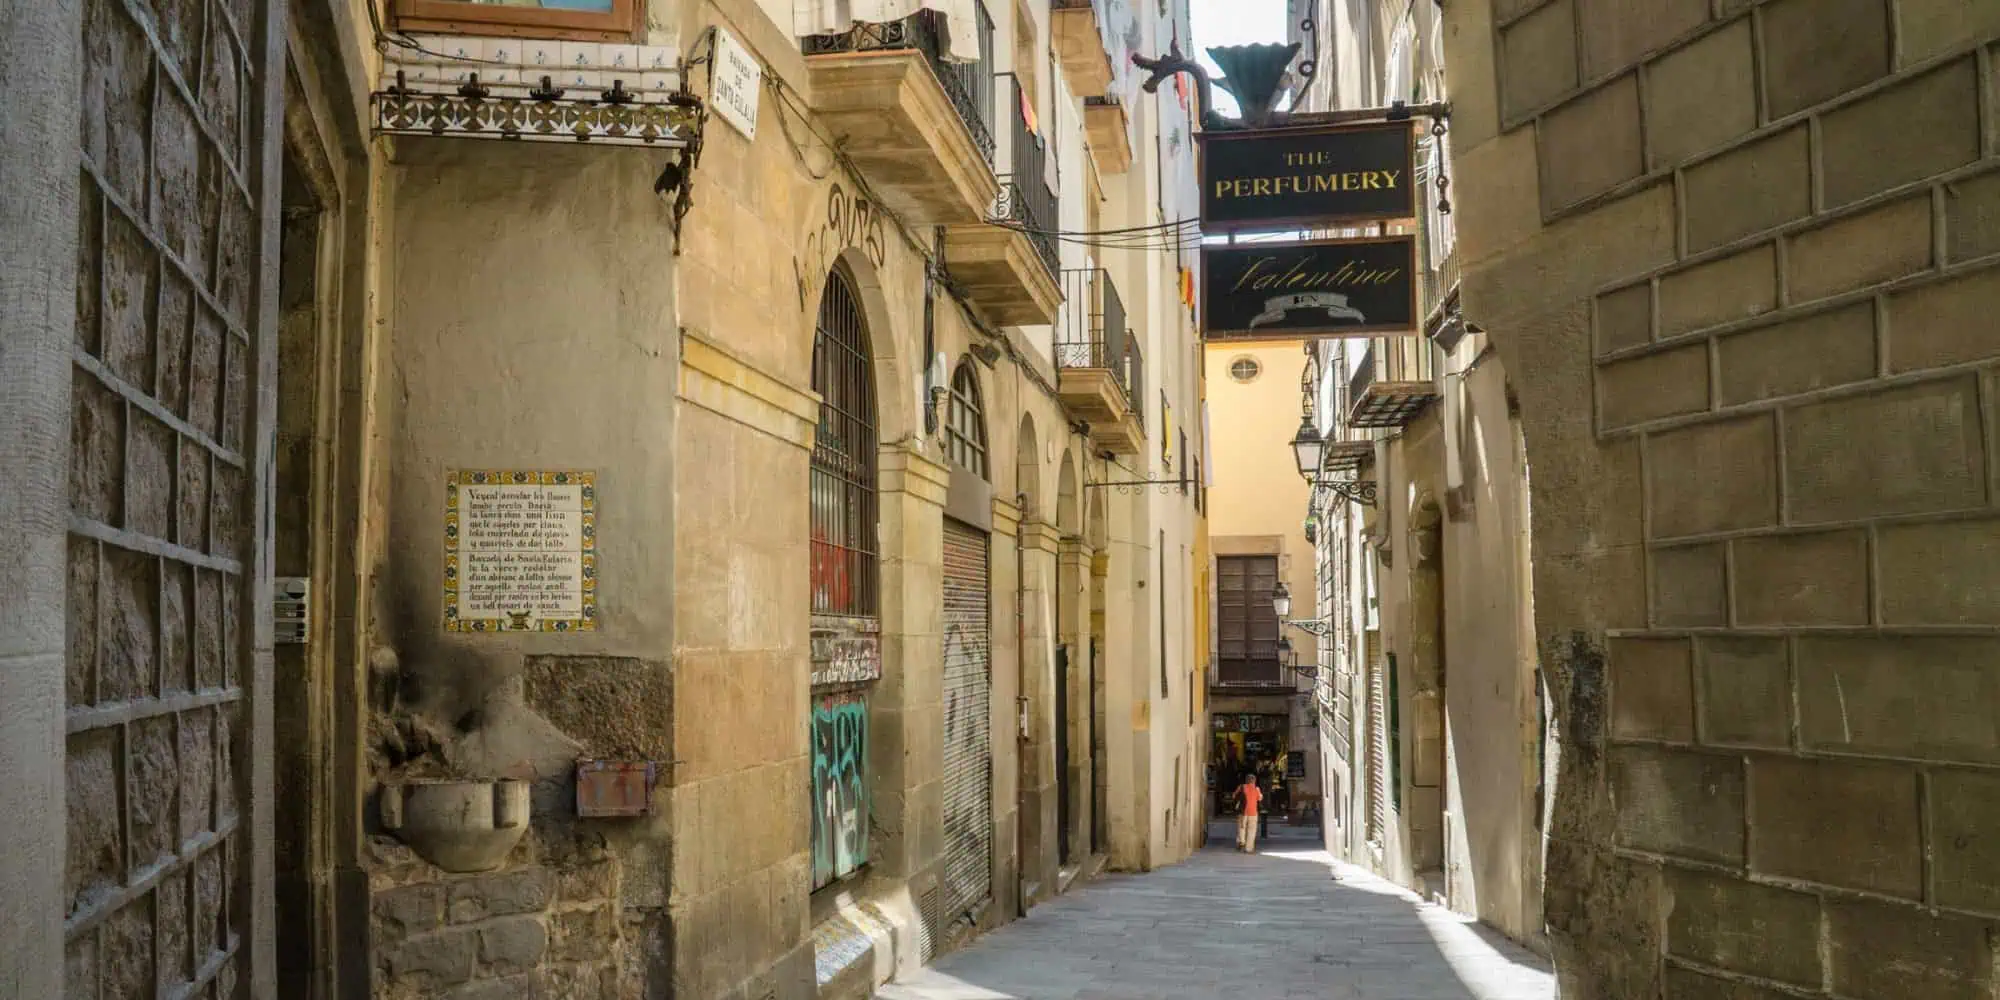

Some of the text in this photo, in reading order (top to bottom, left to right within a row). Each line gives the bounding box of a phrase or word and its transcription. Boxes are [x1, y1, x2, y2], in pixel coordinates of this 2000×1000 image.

[735, 74, 743, 89] DE
[1285, 151, 1331, 166] THE
[1215, 169, 1400, 198] PERFUMERY
[1230, 251, 1400, 295] Valentina
[504, 553, 515, 562] de
[480, 564, 489, 572] la
